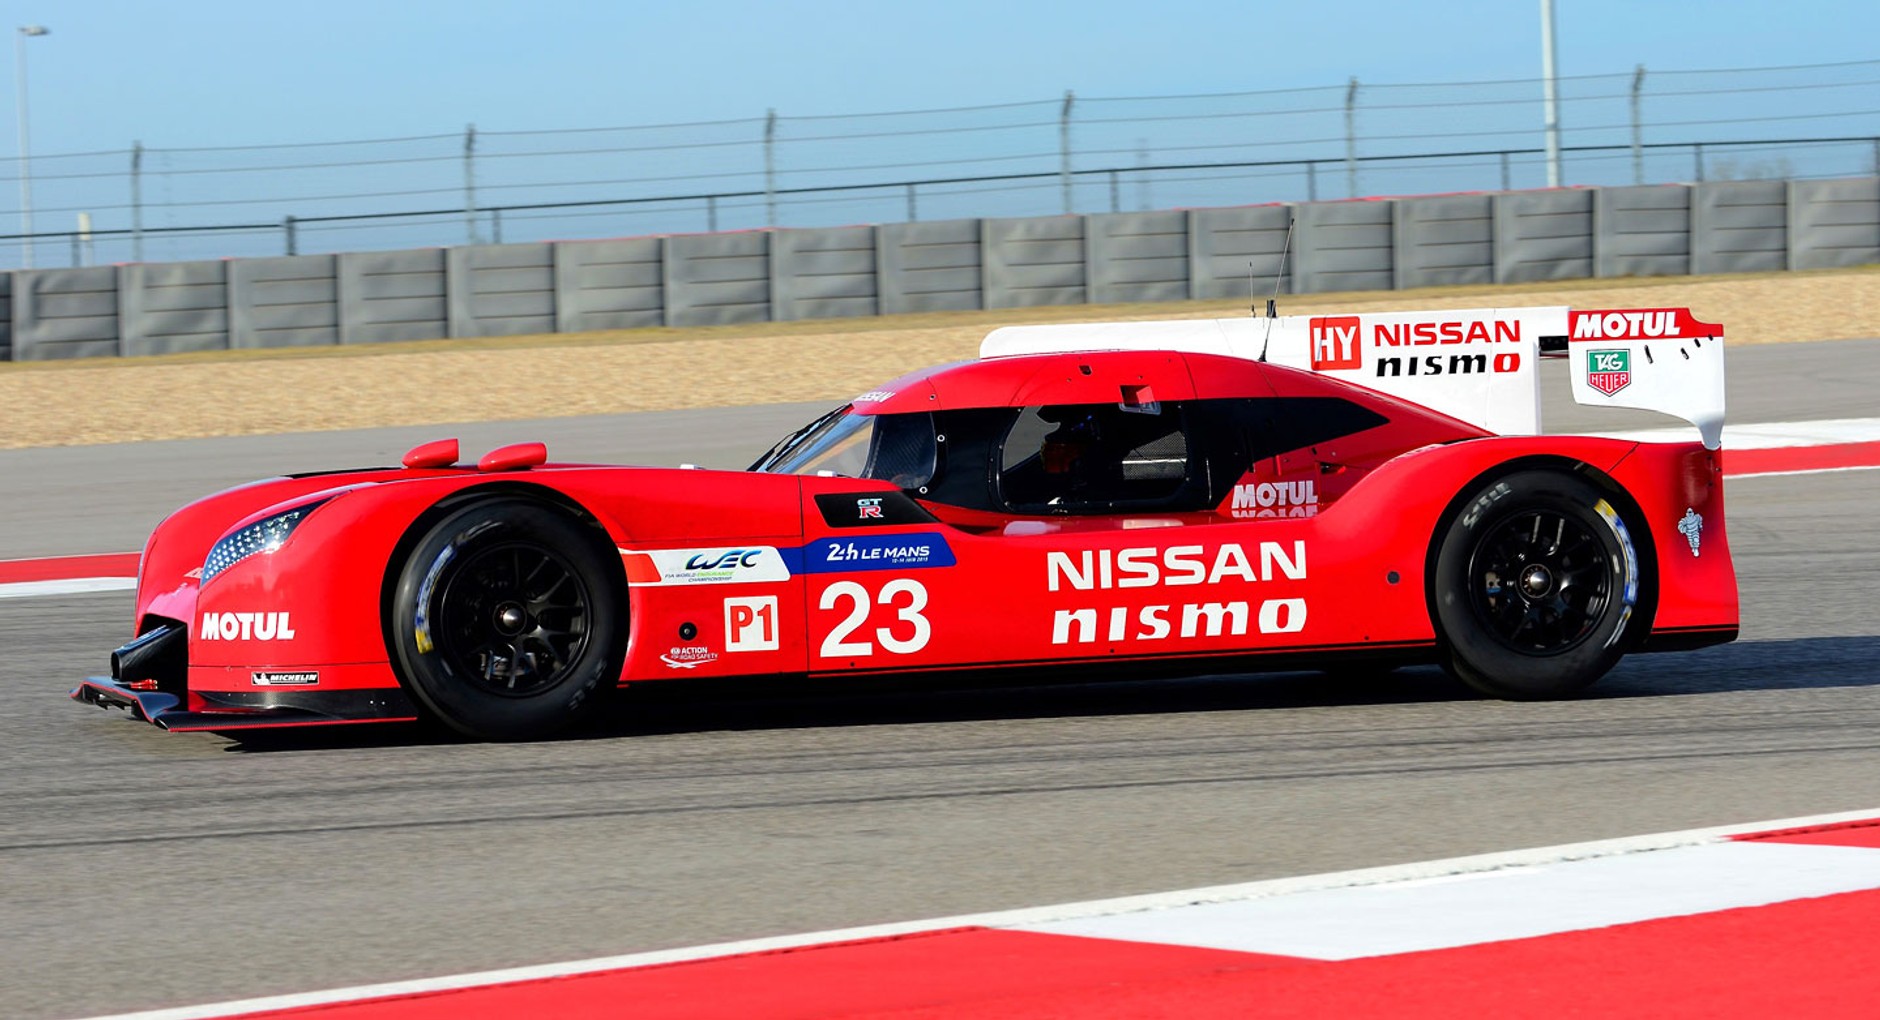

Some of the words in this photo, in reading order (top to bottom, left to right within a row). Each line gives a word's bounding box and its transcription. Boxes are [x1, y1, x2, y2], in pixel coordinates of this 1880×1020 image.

[1374, 320, 1520, 347] NISSAN
[1574, 311, 1680, 338] MOTUL
[1313, 326, 1357, 363] HY
[1376, 353, 1521, 377] nismo
[1594, 353, 1624, 371] TAG
[1591, 373, 1628, 391] HEUER
[857, 498, 883, 506] GT
[1231, 480, 1318, 509] MOTUL
[859, 505, 884, 519] R
[685, 549, 762, 570] WEC
[826, 543, 858, 561] 24h
[861, 549, 881, 559] LE
[883, 546, 930, 559] MANS
[1047, 540, 1307, 592] NISSAN
[201, 611, 295, 641] MOTUL
[730, 604, 773, 643] P1
[819, 579, 931, 658] 23
[1052, 598, 1307, 644] nismo
